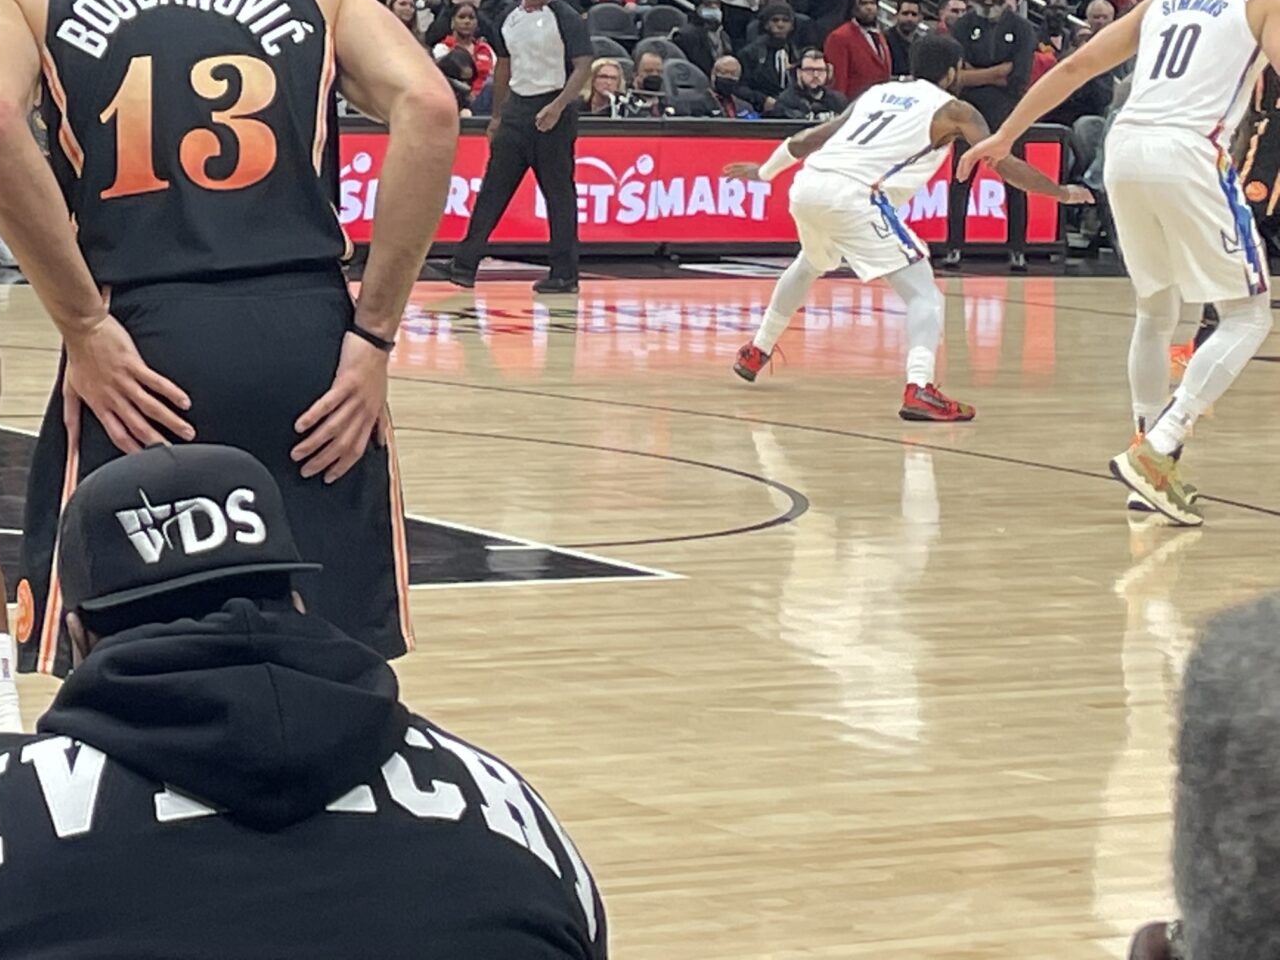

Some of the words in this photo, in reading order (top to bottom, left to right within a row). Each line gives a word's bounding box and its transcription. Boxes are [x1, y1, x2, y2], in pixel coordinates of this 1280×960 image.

[1149, 23, 1202, 80] 10
[99, 54, 278, 200] 13
[846, 110, 897, 145] 11
